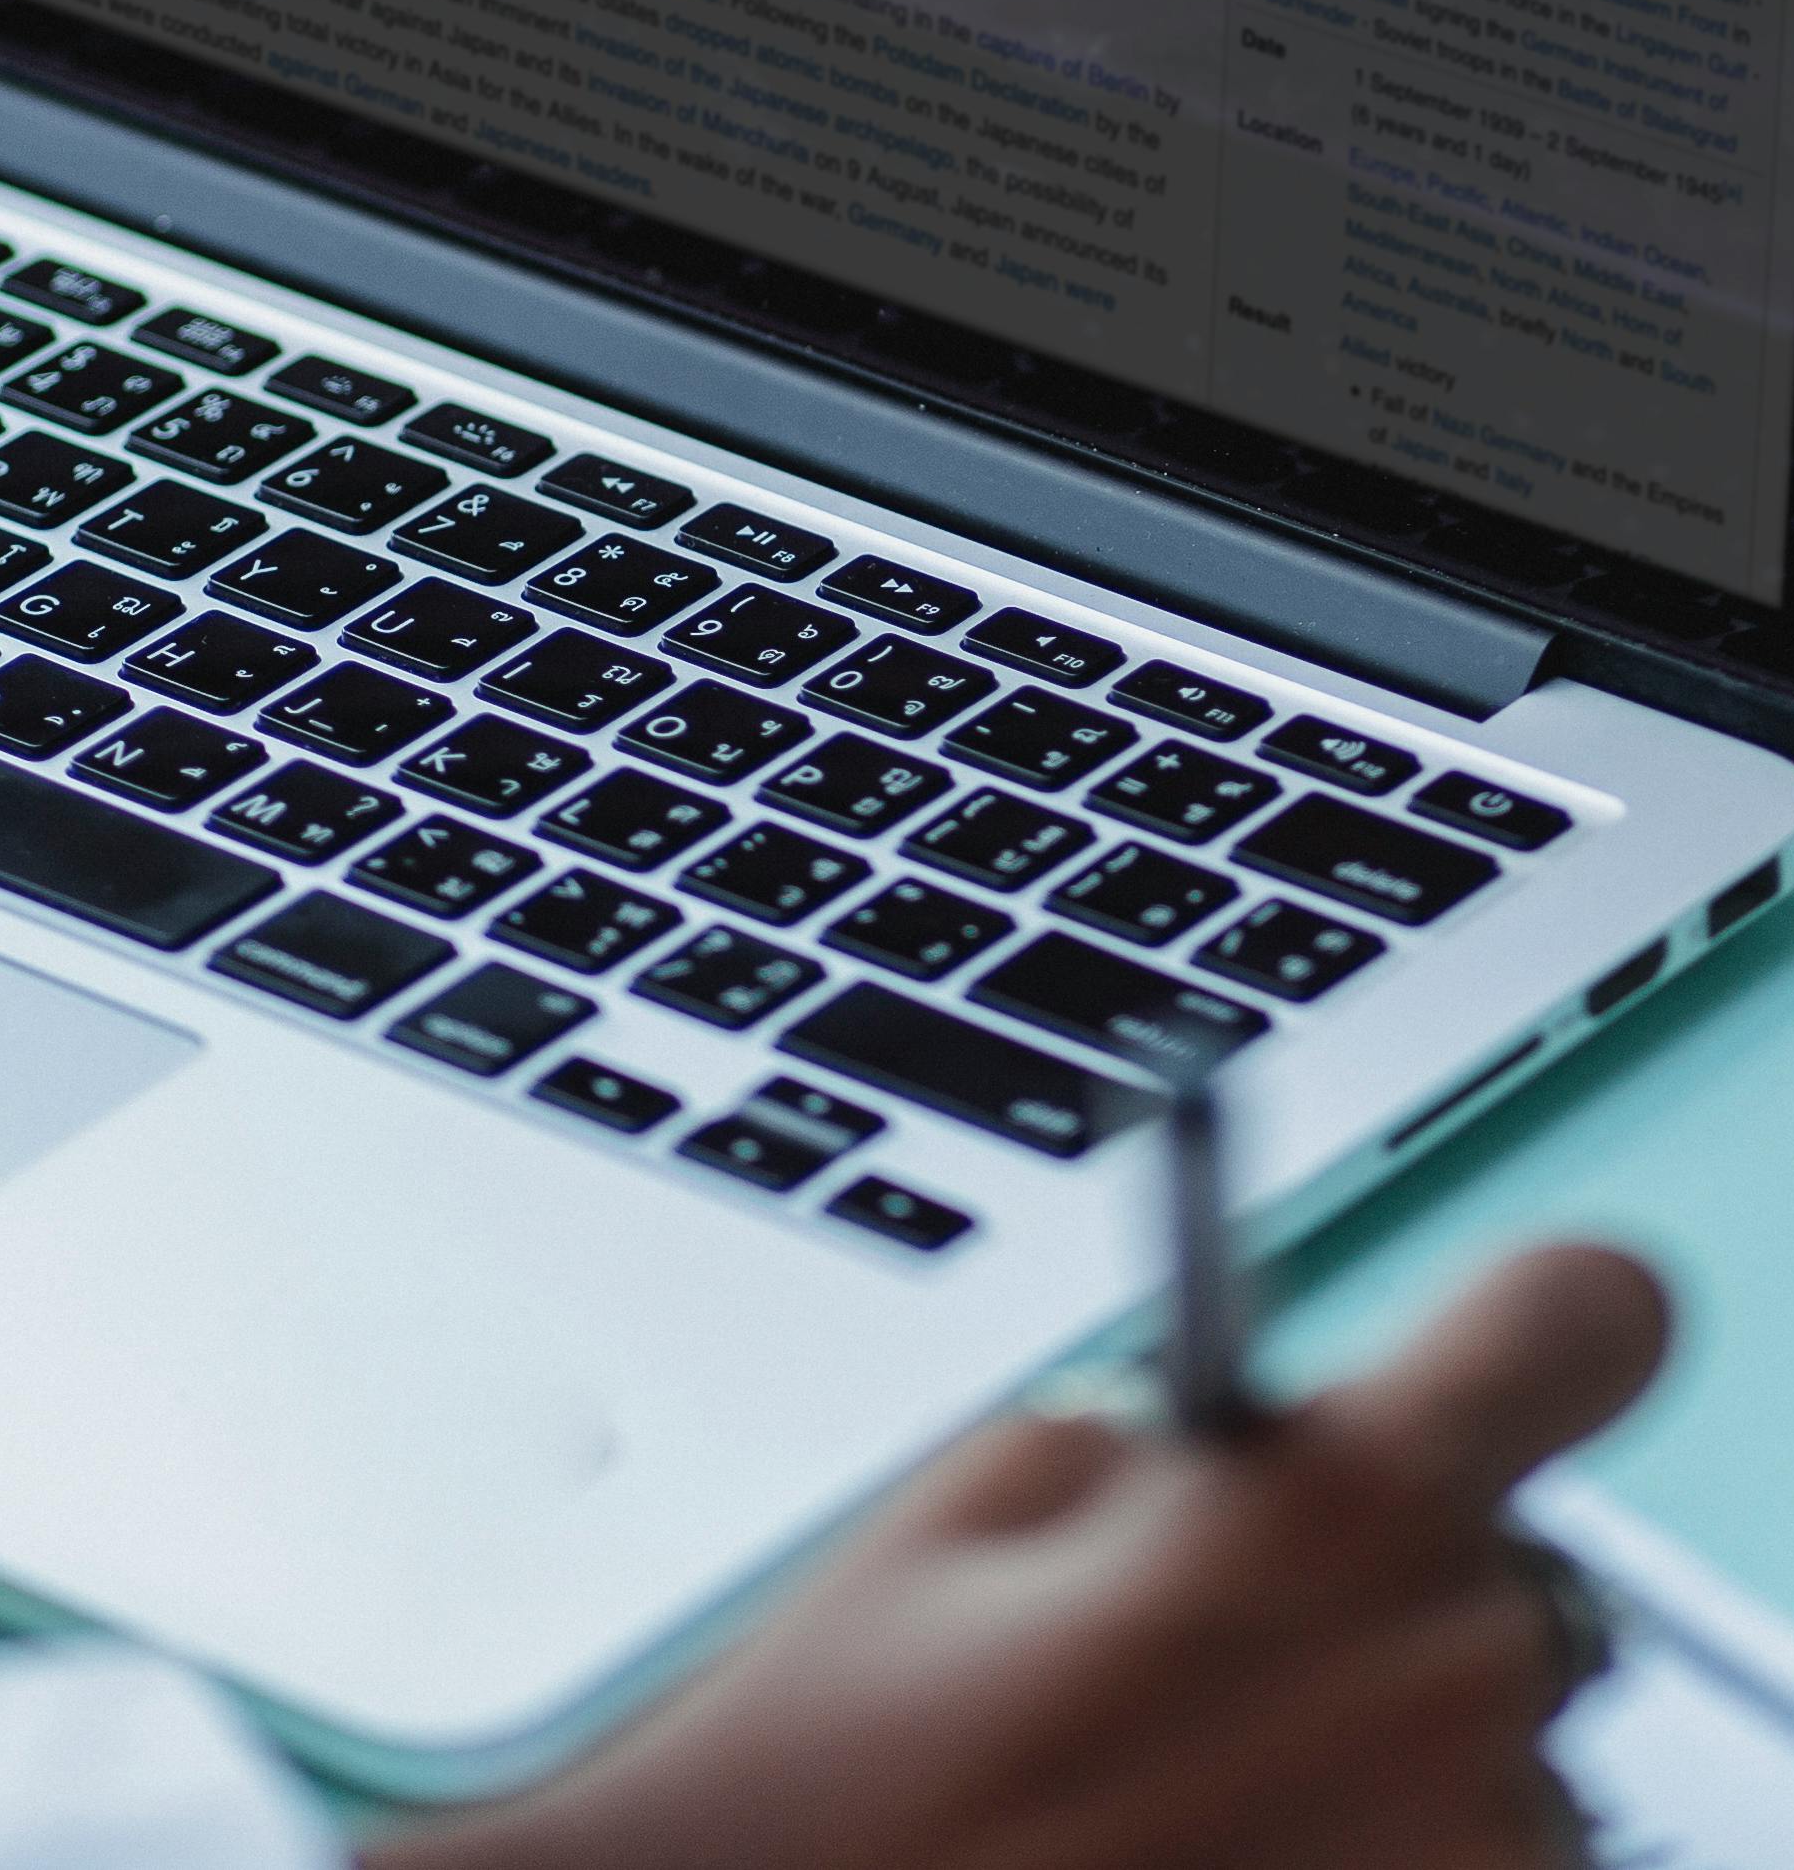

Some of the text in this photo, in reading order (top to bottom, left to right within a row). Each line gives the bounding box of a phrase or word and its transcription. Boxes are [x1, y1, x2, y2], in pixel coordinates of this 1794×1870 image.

[1578, 11, 1612, 40] the
[1239, 25, 1288, 61] Date
[1235, 107, 1324, 155] Location
[1369, 70, 1474, 123] September
[1479, 107, 1527, 141] 1939
[1563, 133, 1670, 187] September
[1374, 113, 1428, 147] years
[1430, 132, 1469, 160] and
[1487, 149, 1532, 183] day)
[1226, 293, 1293, 336] Result
[1394, 355, 1457, 395] victory
[154, 416, 192, 440] 5
[285, 468, 319, 487] 6
[631, 498, 657, 511] F7
[108, 509, 144, 531] T
[417, 514, 456, 534] 7
[771, 549, 796, 564] F8
[240, 559, 278, 581] Y
[553, 567, 587, 586] 8
[19, 594, 61, 616] G
[915, 602, 941, 615] F9
[370, 610, 415, 634] U
[690, 619, 723, 637] 9
[146, 642, 196, 668] H
[1052, 653, 1085, 669] F10
[502, 661, 532, 680] I
[829, 670, 864, 690] 0
[284, 698, 323, 715] J
[645, 715, 687, 739] O
[94, 739, 144, 767] N
[419, 746, 466, 773] K
[780, 764, 824, 785] P
[230, 793, 288, 826] M
[558, 799, 591, 825] L
